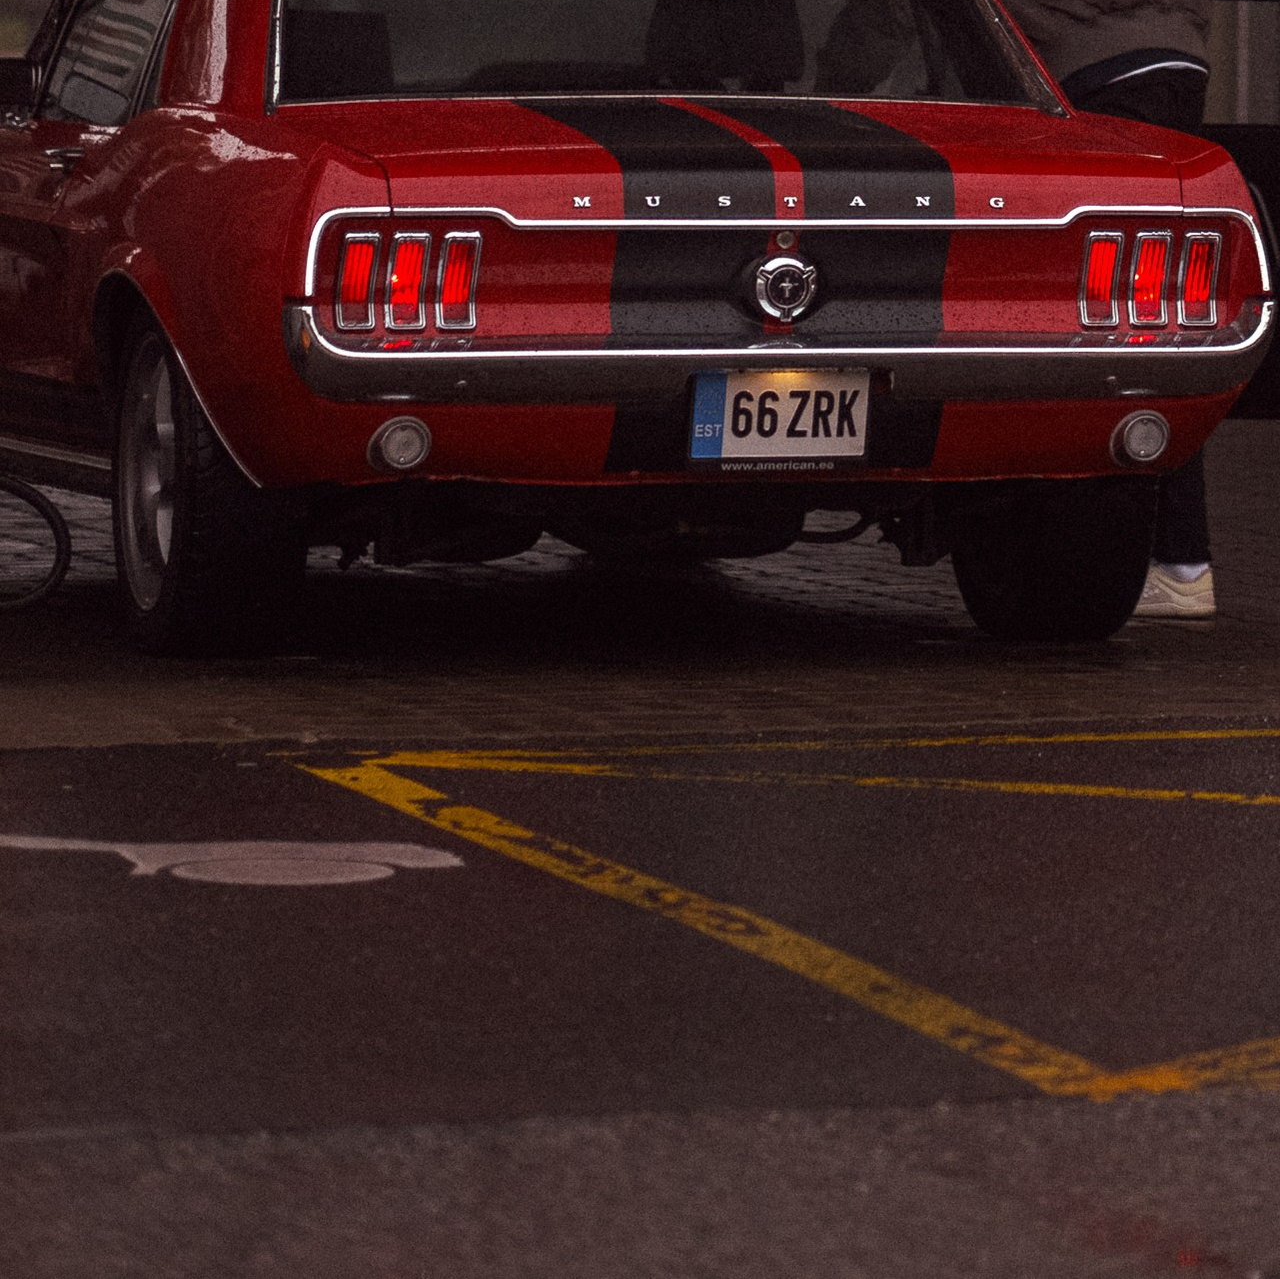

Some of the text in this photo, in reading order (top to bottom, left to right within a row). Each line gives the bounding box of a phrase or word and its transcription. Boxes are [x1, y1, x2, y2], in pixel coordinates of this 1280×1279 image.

[573, 195, 1005, 210] MUSTANG
[731, 389, 861, 438] 66 ZRK
[694, 424, 722, 438] EST
